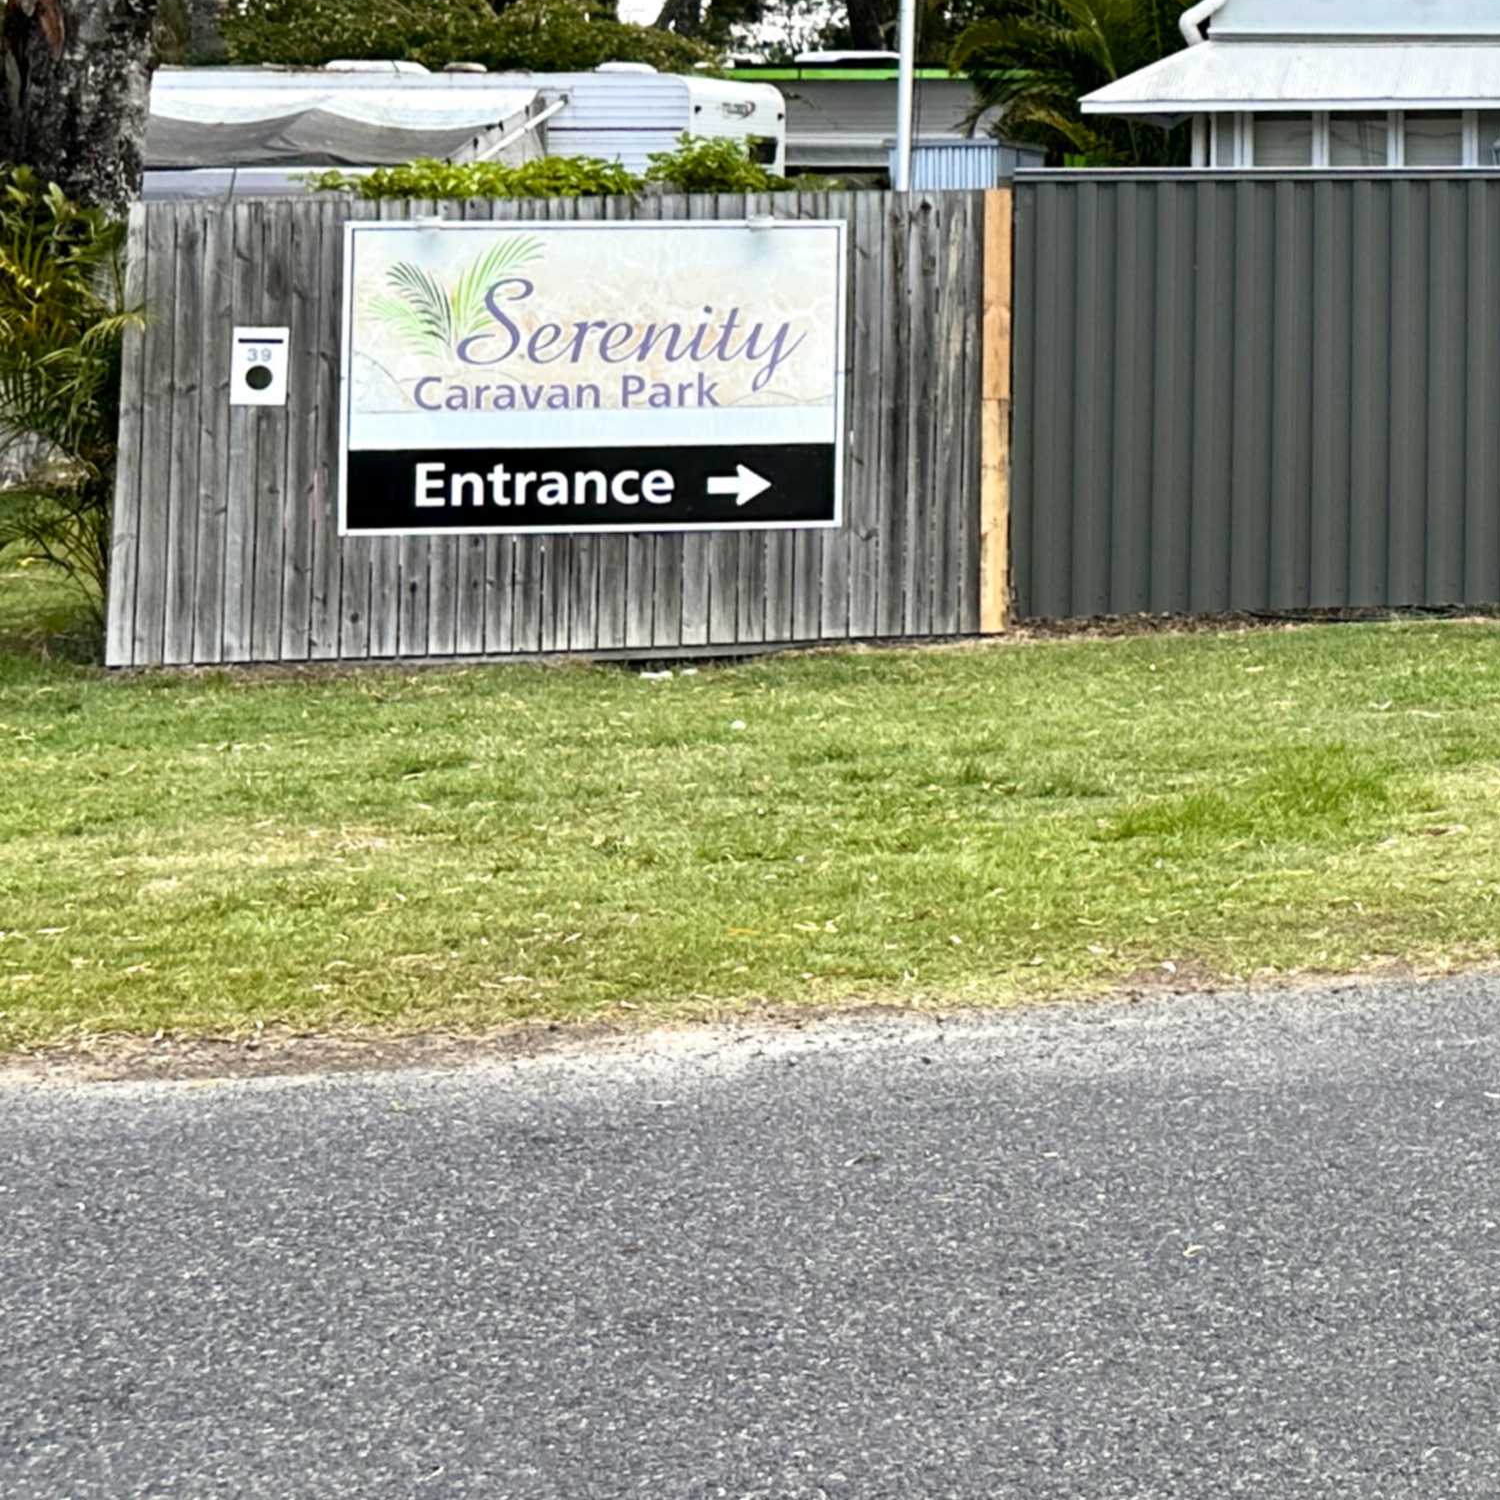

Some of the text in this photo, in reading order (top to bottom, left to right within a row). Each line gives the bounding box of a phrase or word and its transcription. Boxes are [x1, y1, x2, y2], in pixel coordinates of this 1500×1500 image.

[246, 347, 273, 363] 39
[456, 277, 808, 392] Serenity
[413, 372, 721, 411] Caravan Park
[414, 462, 675, 507] Entrance
